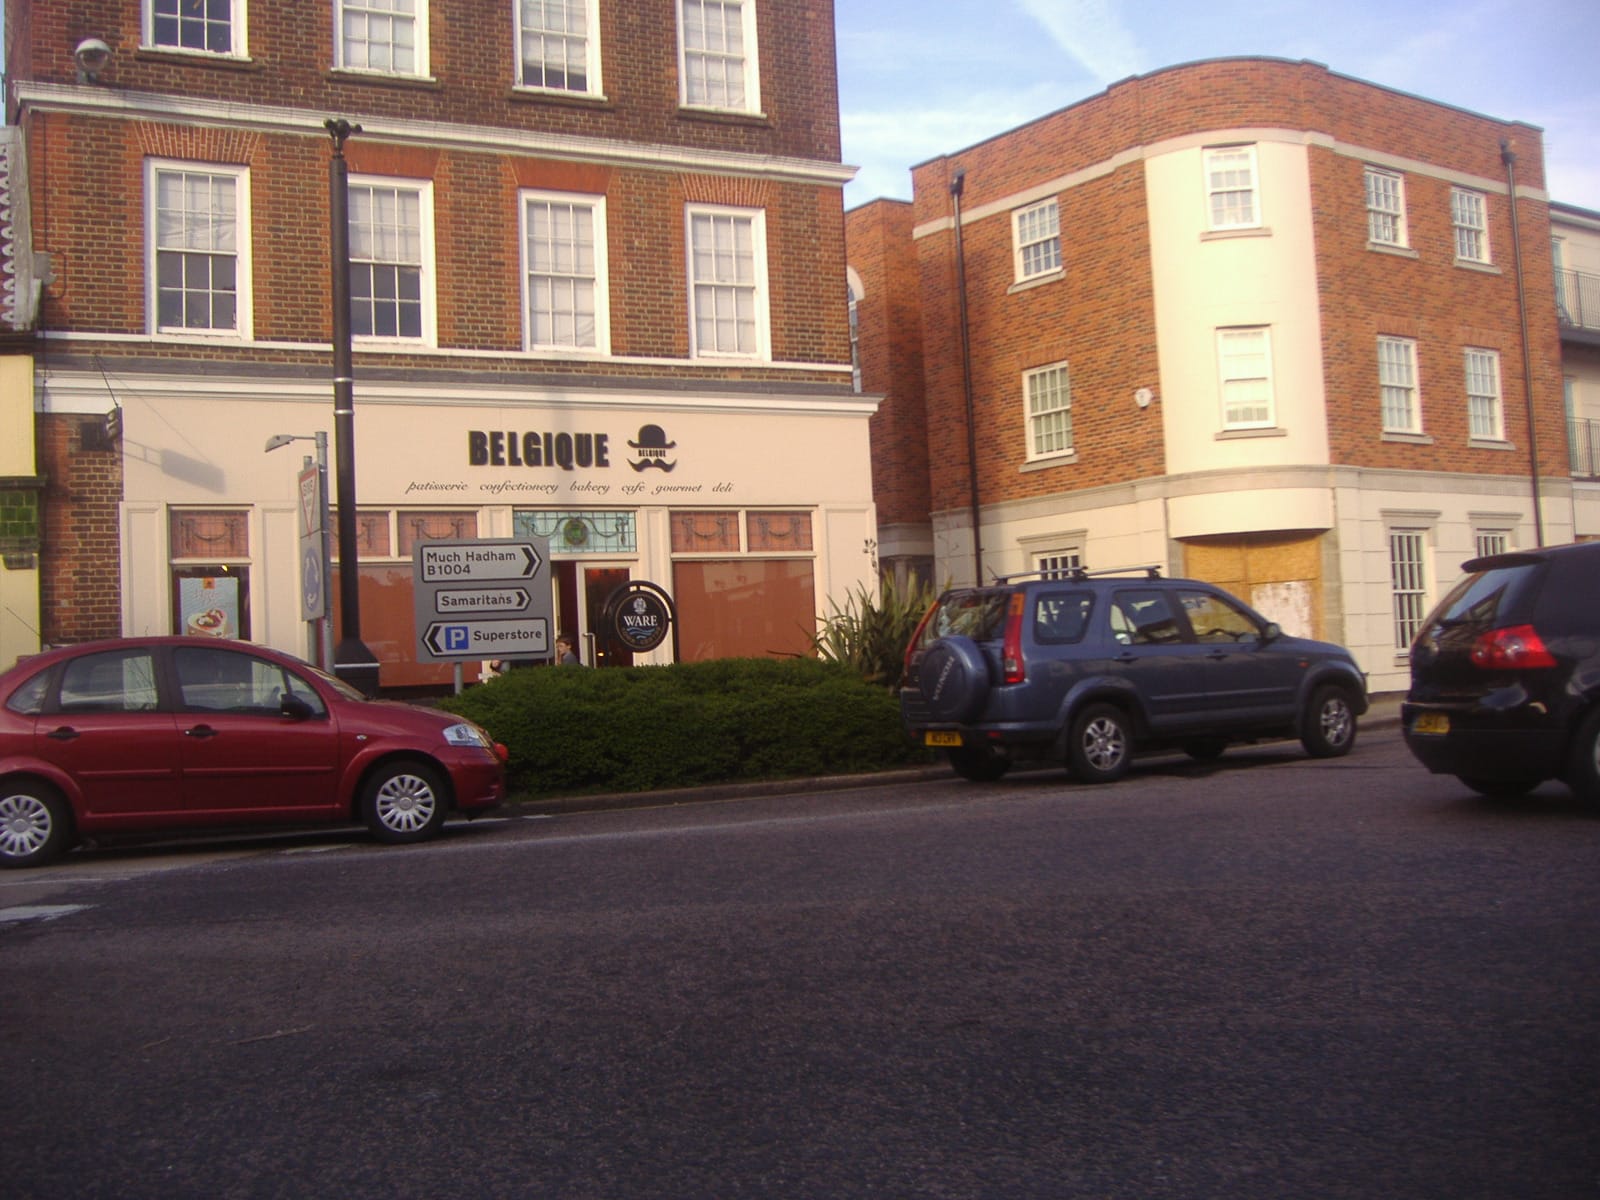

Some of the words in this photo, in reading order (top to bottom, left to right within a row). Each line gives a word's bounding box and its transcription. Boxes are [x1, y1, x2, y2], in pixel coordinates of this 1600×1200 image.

[468, 430, 610, 471] BELGIQUE
[405, 480, 469, 495] patisserie
[479, 480, 560, 495] confectionery
[569, 480, 610, 496] bakery
[650, 484, 702, 496] gourmet
[712, 482, 734, 493] deli
[427, 552, 461, 563] Much
[466, 551, 516, 561] Hadham
[427, 564, 471, 576] B1004
[441, 594, 513, 607] Samaritans
[623, 615, 658, 627] WARE
[450, 628, 466, 649] P
[473, 629, 543, 642] Superstore
